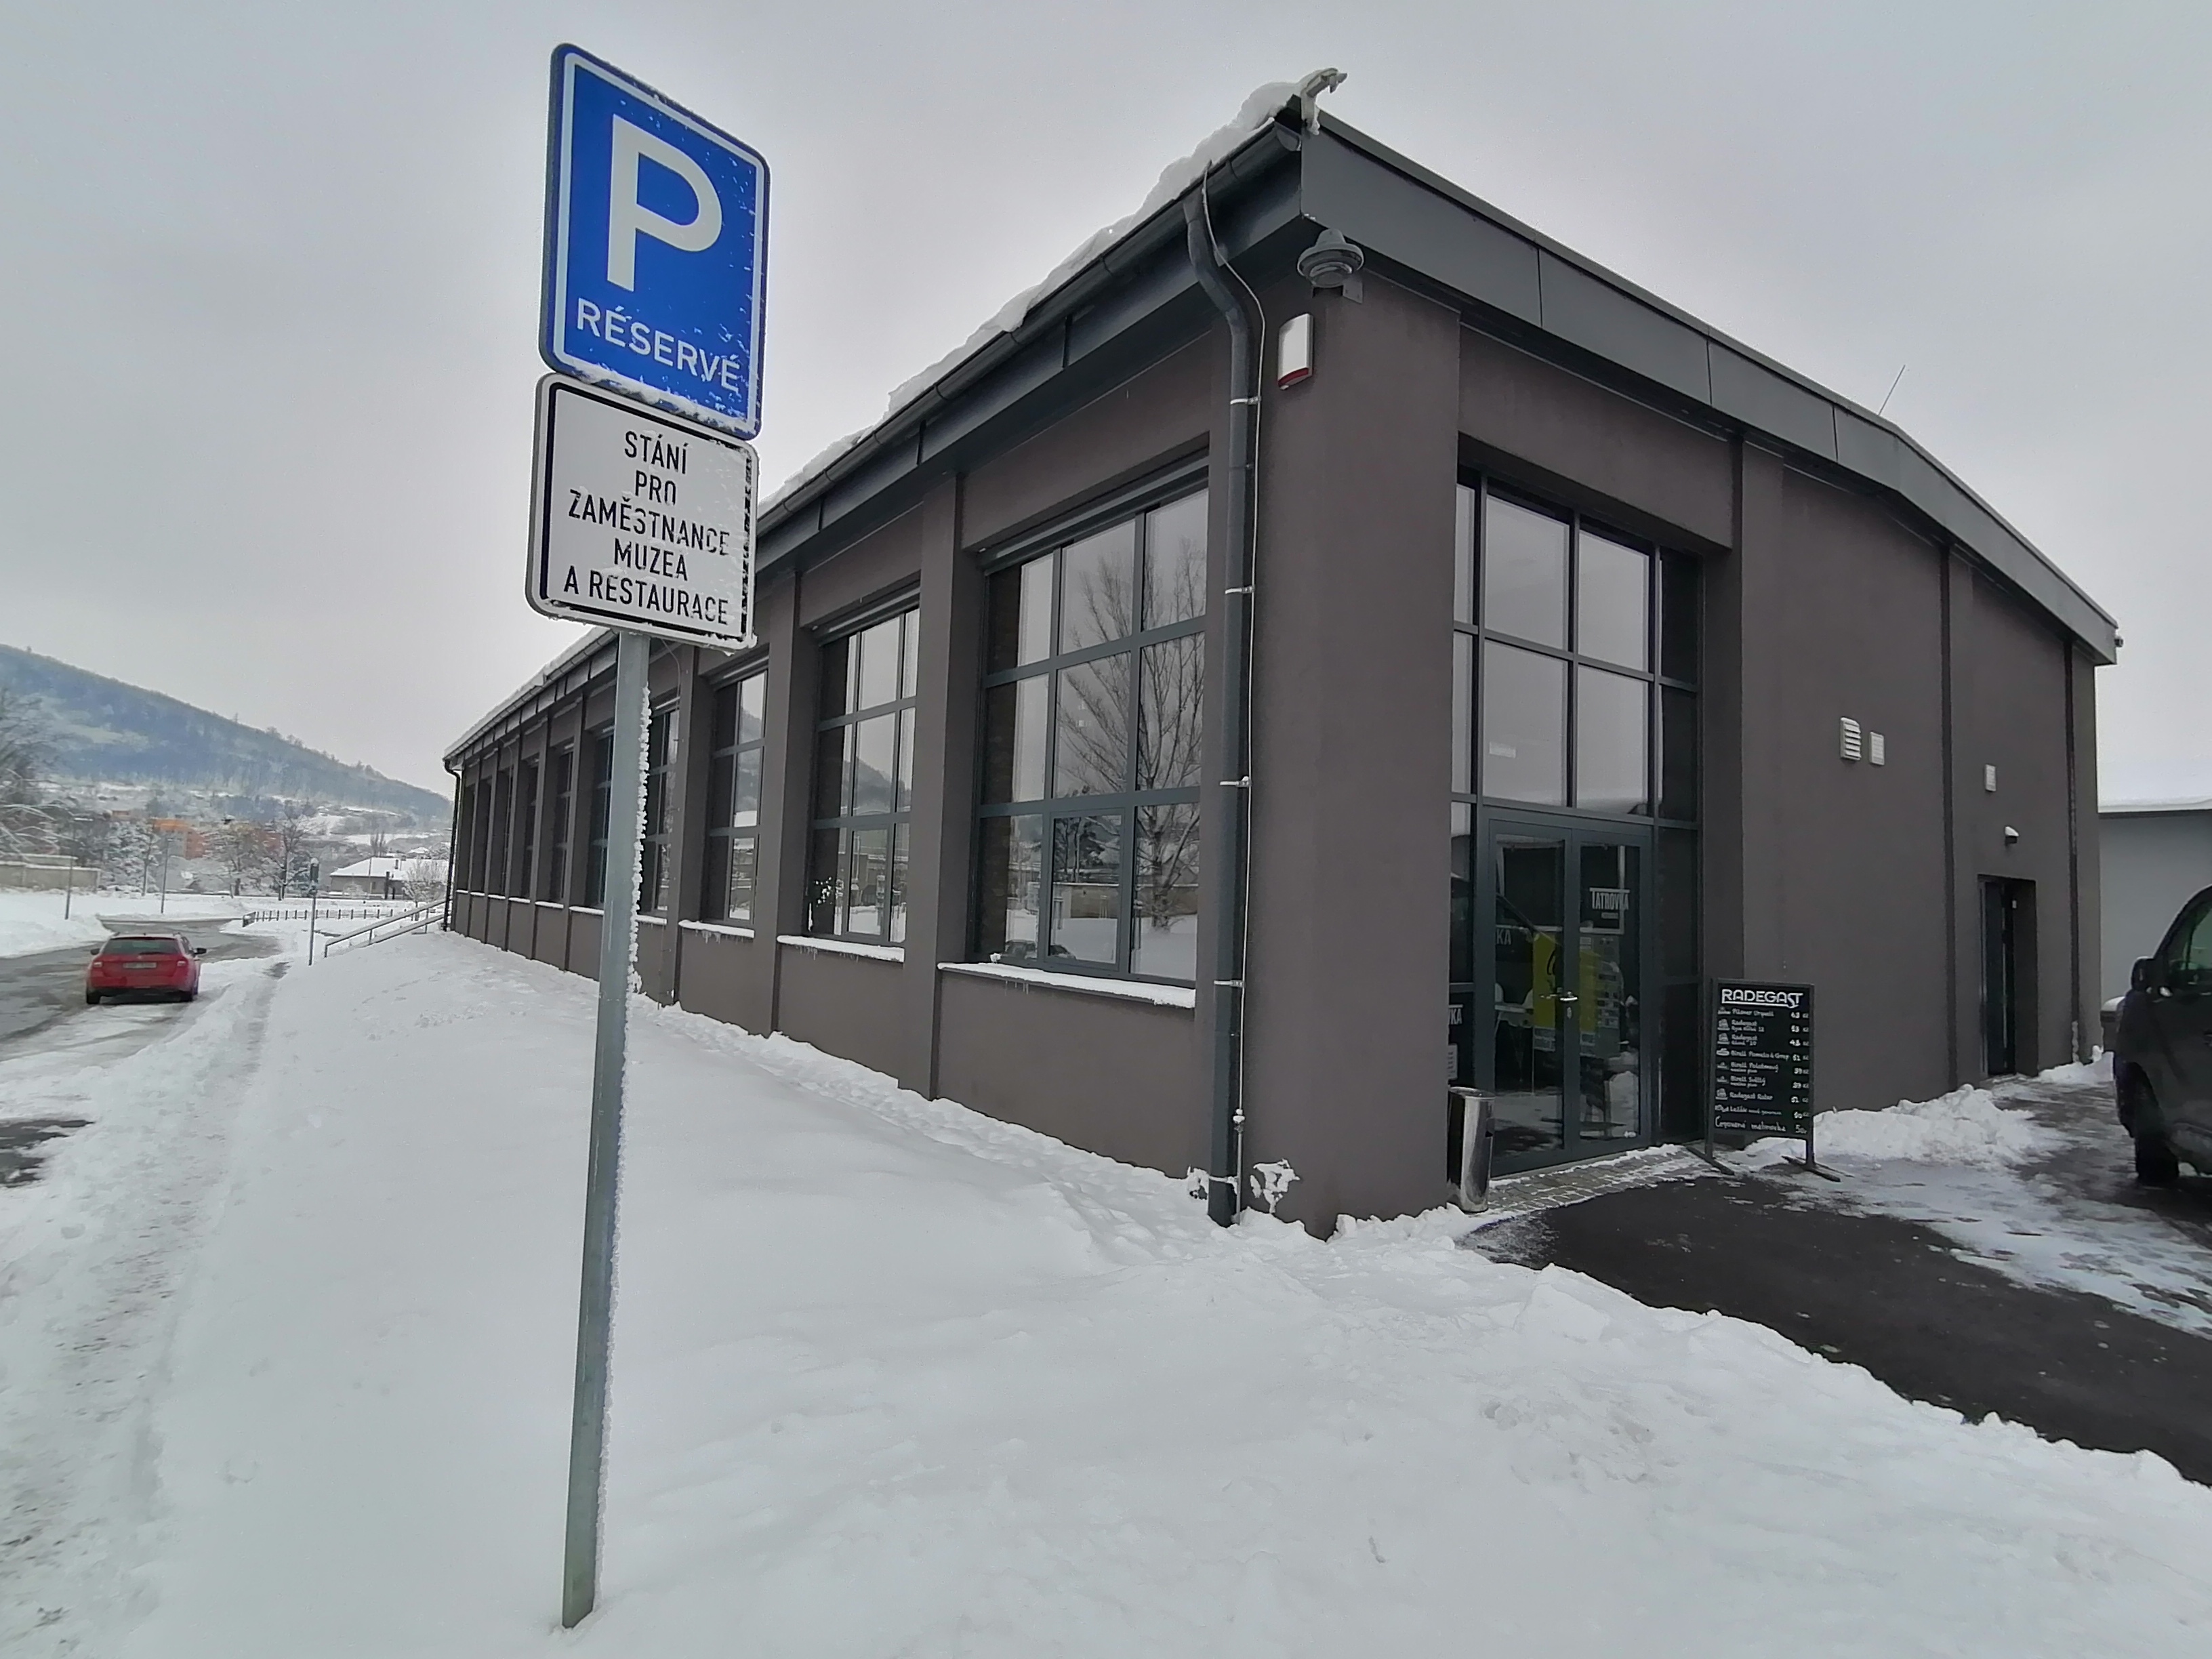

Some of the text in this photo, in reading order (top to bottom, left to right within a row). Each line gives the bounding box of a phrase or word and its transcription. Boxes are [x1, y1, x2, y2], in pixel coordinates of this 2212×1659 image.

[607, 114, 722, 291] P
[577, 298, 741, 393] RÉSERVÉ
[624, 430, 689, 474] STÁNÍ
[634, 470, 676, 507] PRO
[568, 489, 731, 556] ZAMĚSTNANCE
[613, 537, 688, 581] MUZEA
[563, 565, 729, 626] A RESTAURACE
[1721, 988, 1804, 1008] RADEGAST
